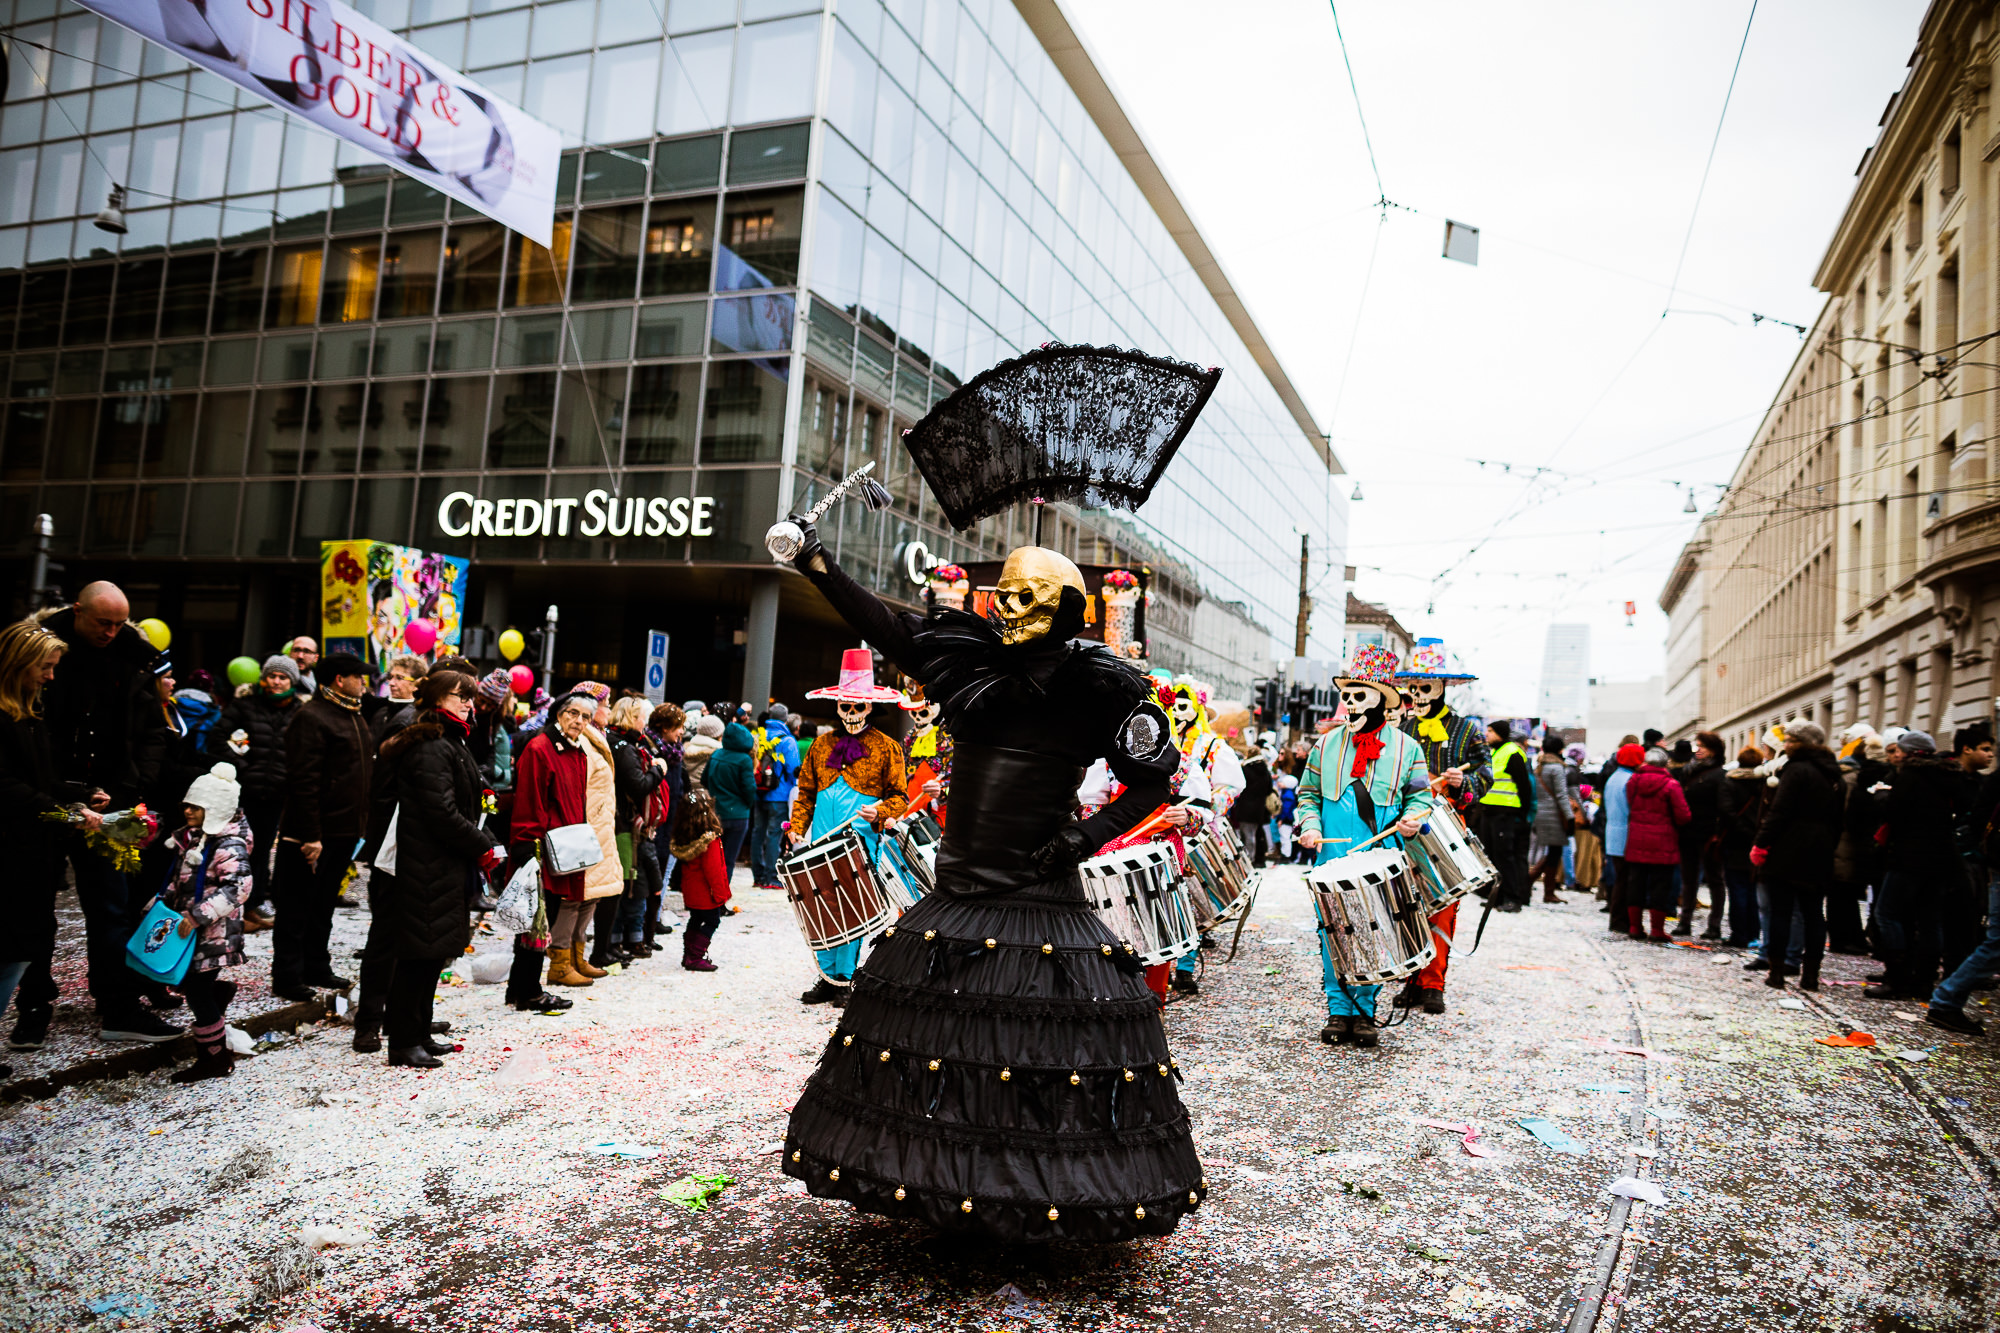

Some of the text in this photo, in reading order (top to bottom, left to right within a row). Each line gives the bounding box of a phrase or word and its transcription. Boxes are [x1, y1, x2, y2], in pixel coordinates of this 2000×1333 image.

[289, 54, 421, 151] GOLD
[432, 83, 460, 127] &
[438, 489, 714, 537] CREDIT SUISSE
